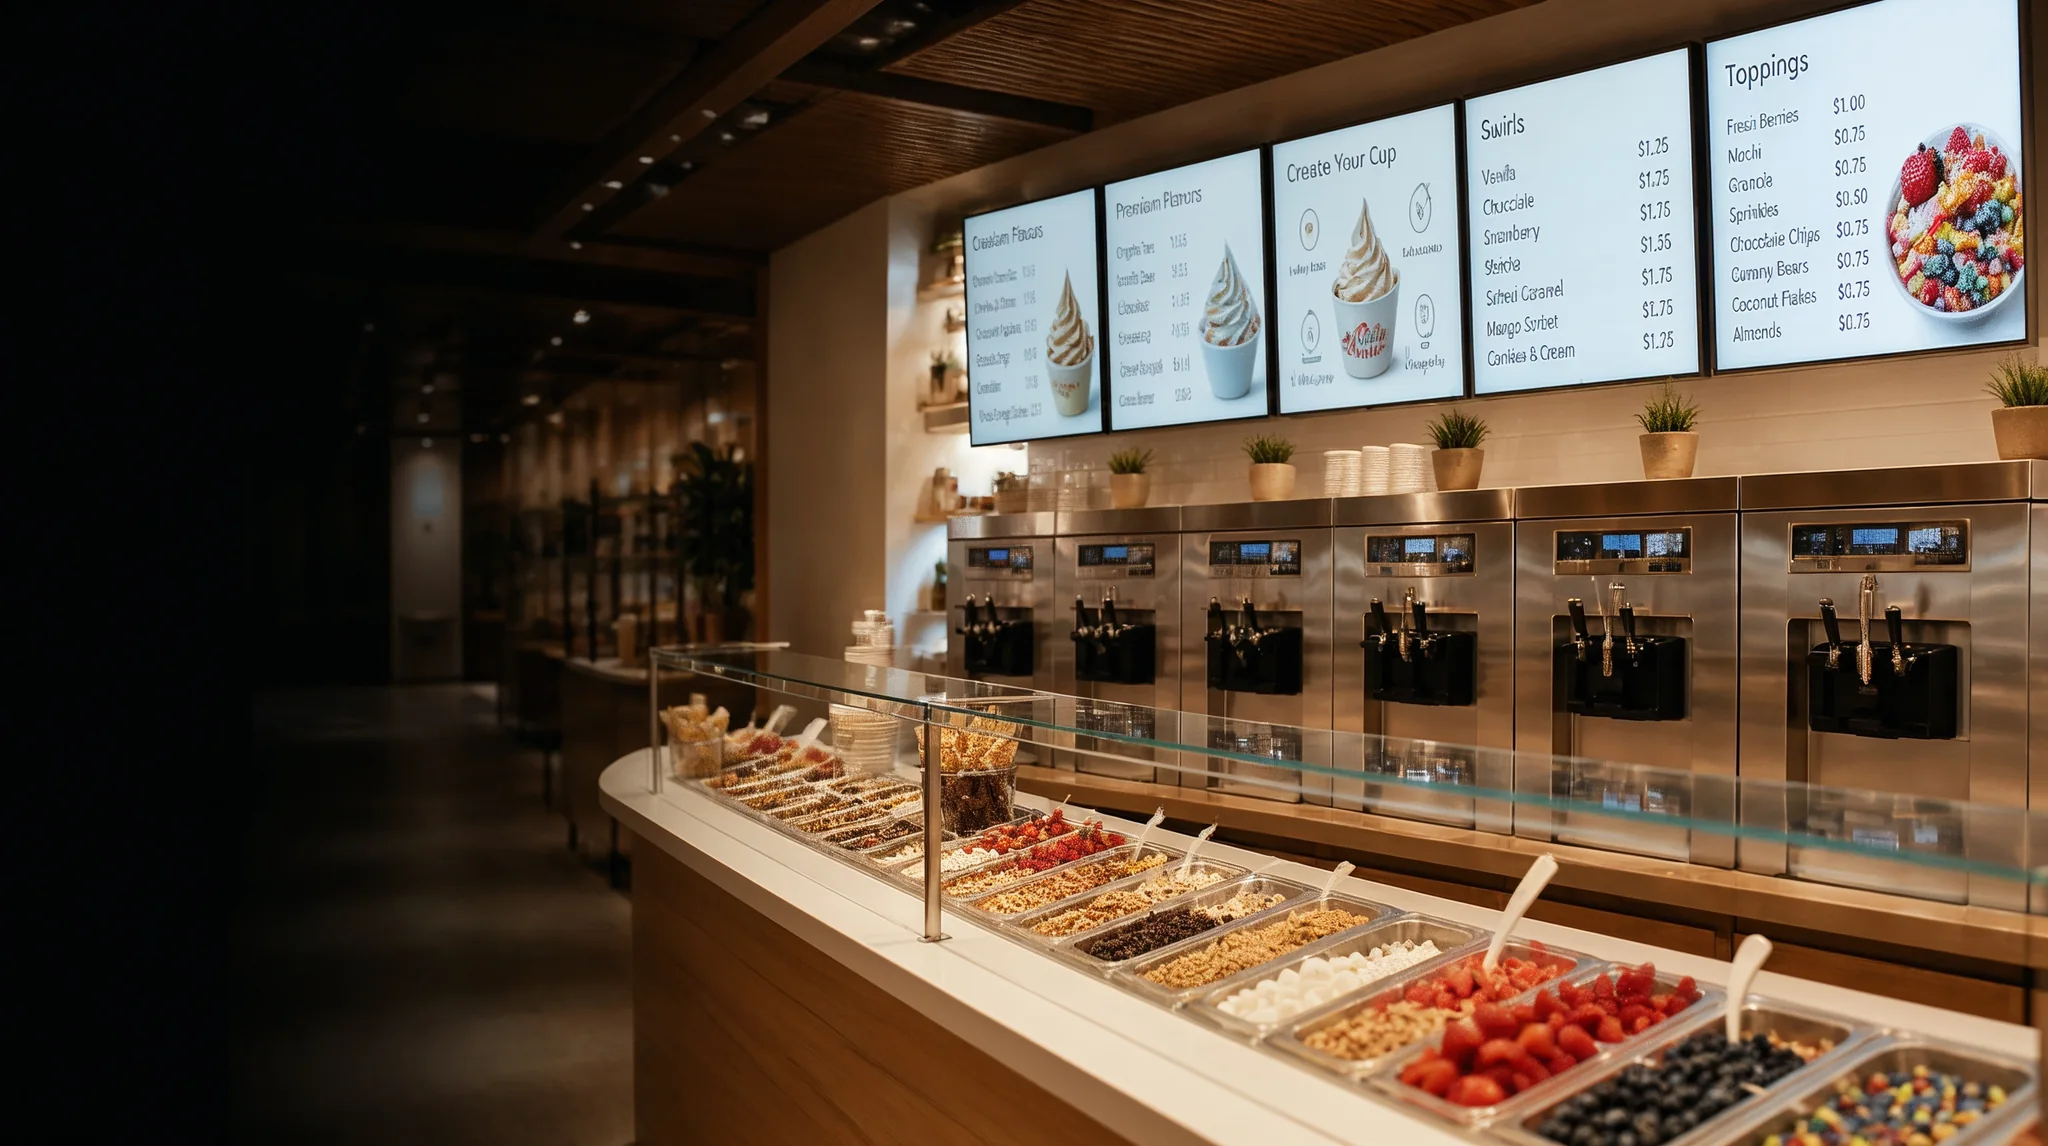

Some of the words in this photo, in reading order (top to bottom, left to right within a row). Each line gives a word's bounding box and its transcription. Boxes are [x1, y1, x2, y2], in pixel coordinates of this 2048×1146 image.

[1725, 53, 1809, 90] Toppings
[1833, 94, 1866, 115] $1.00
[1481, 113, 1525, 140] Swirls
[1834, 125, 1866, 146] $0.75
[1638, 137, 1669, 157] $1.25
[1287, 159, 1331, 183] Create
[1334, 153, 1366, 173] Your
[1369, 145, 1397, 169] Cup
[1835, 156, 1867, 177] $0.75
[1639, 169, 1670, 189] $1.75
[1836, 187, 1868, 208] $0.50
[1640, 201, 1671, 221] $1.75
[1788, 227, 1820, 247] Chips
[1836, 219, 1869, 239] $0.75
[1837, 250, 1869, 270] $0.75
[1641, 266, 1673, 286] $1.75
[1732, 293, 1779, 313] Coconut
[1838, 280, 1870, 301] $0.75
[1838, 312, 1870, 332] $0.75
